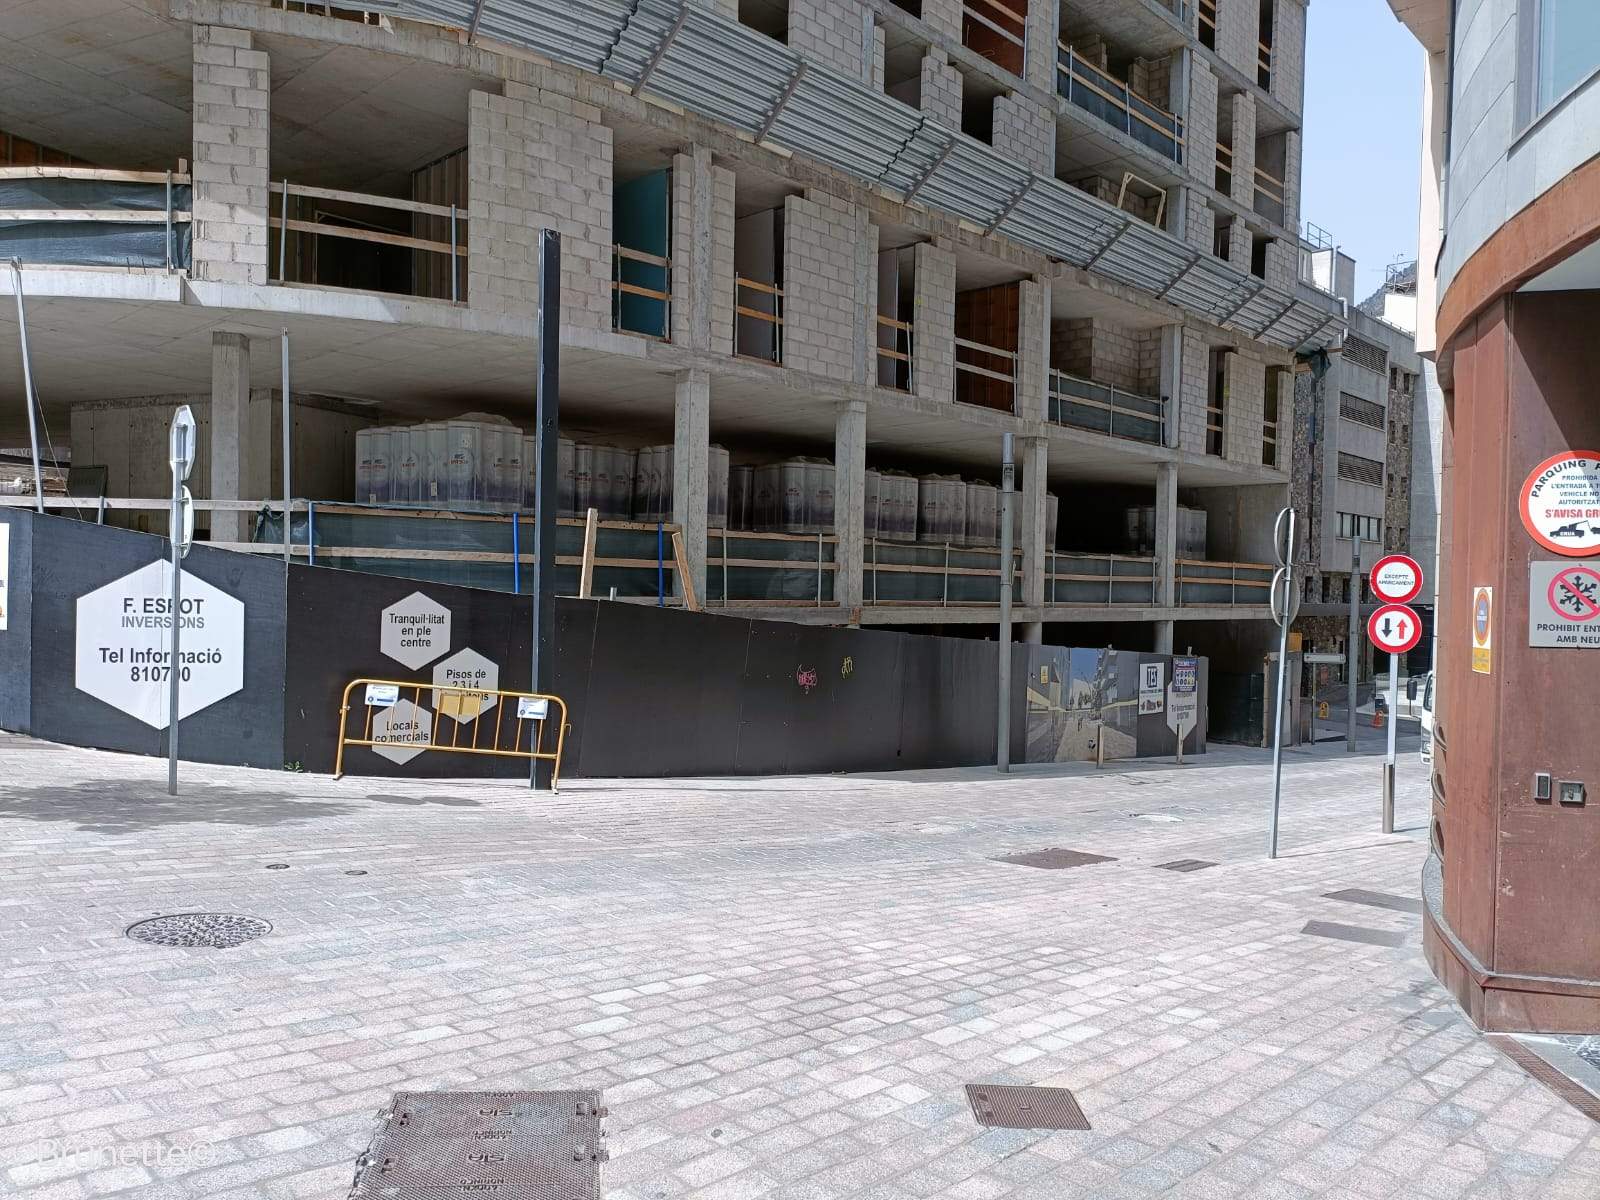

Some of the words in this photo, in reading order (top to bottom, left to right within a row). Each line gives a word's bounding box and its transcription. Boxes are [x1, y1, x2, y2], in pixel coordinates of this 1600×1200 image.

[1531, 459, 1587, 498] PARQUING
[1545, 508, 1583, 519] S'AVISA
[123, 597, 137, 614] F.
[120, 615, 205, 629] INVERSONS
[1536, 623, 1581, 632] PROHIBIT
[401, 627, 414, 636] en
[416, 625, 432, 637] ple
[400, 638, 432, 648] centre
[1556, 635, 1578, 643] AMB
[99, 647, 124, 664] Tel
[130, 666, 191, 682] 81070
[446, 669, 472, 679] Pisos
[474, 669, 487, 679] de
[473, 680, 480, 689] 4
[386, 720, 420, 732] Locals
